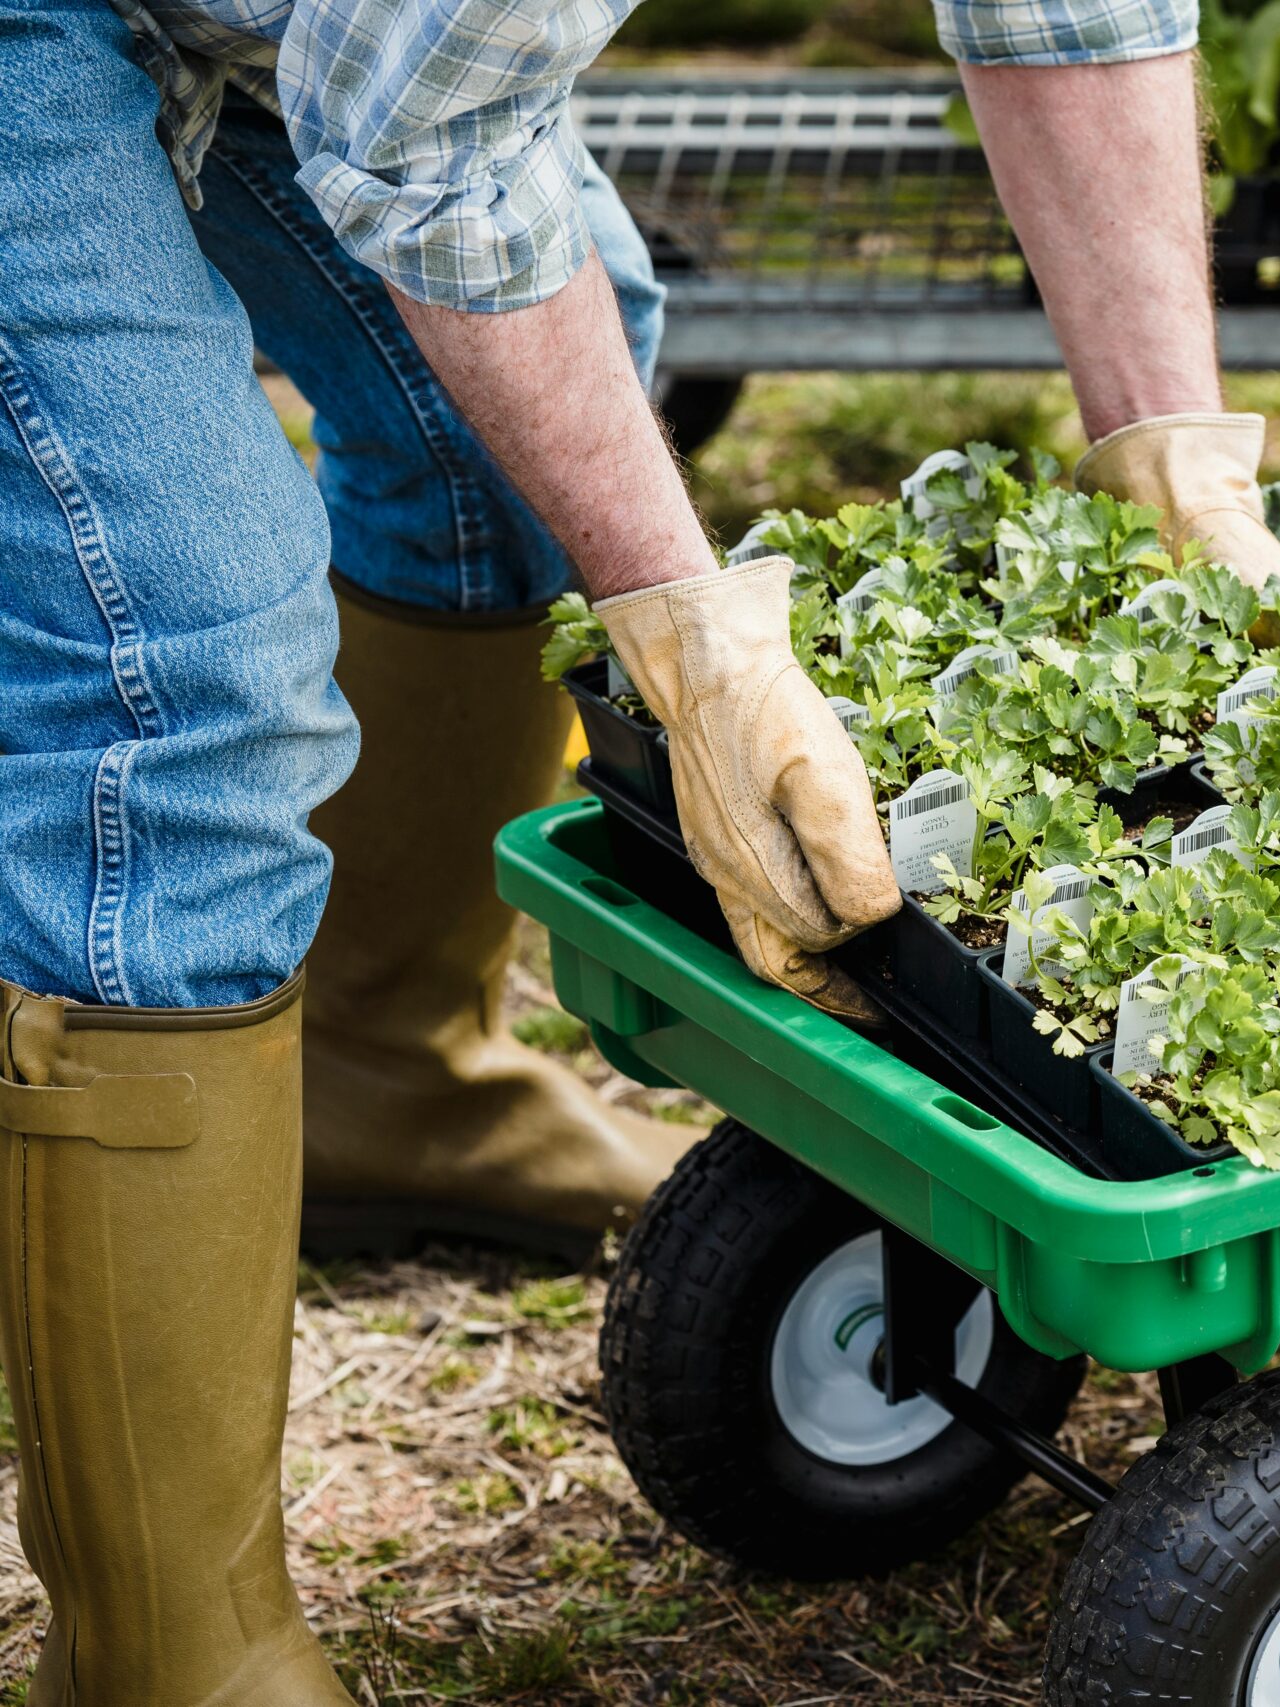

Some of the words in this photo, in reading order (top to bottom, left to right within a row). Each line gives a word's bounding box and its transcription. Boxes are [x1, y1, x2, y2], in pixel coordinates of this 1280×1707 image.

[922, 815, 945, 826] TANGO
[920, 820, 949, 835] CELERY
[1148, 1009, 1167, 1018] LERY
